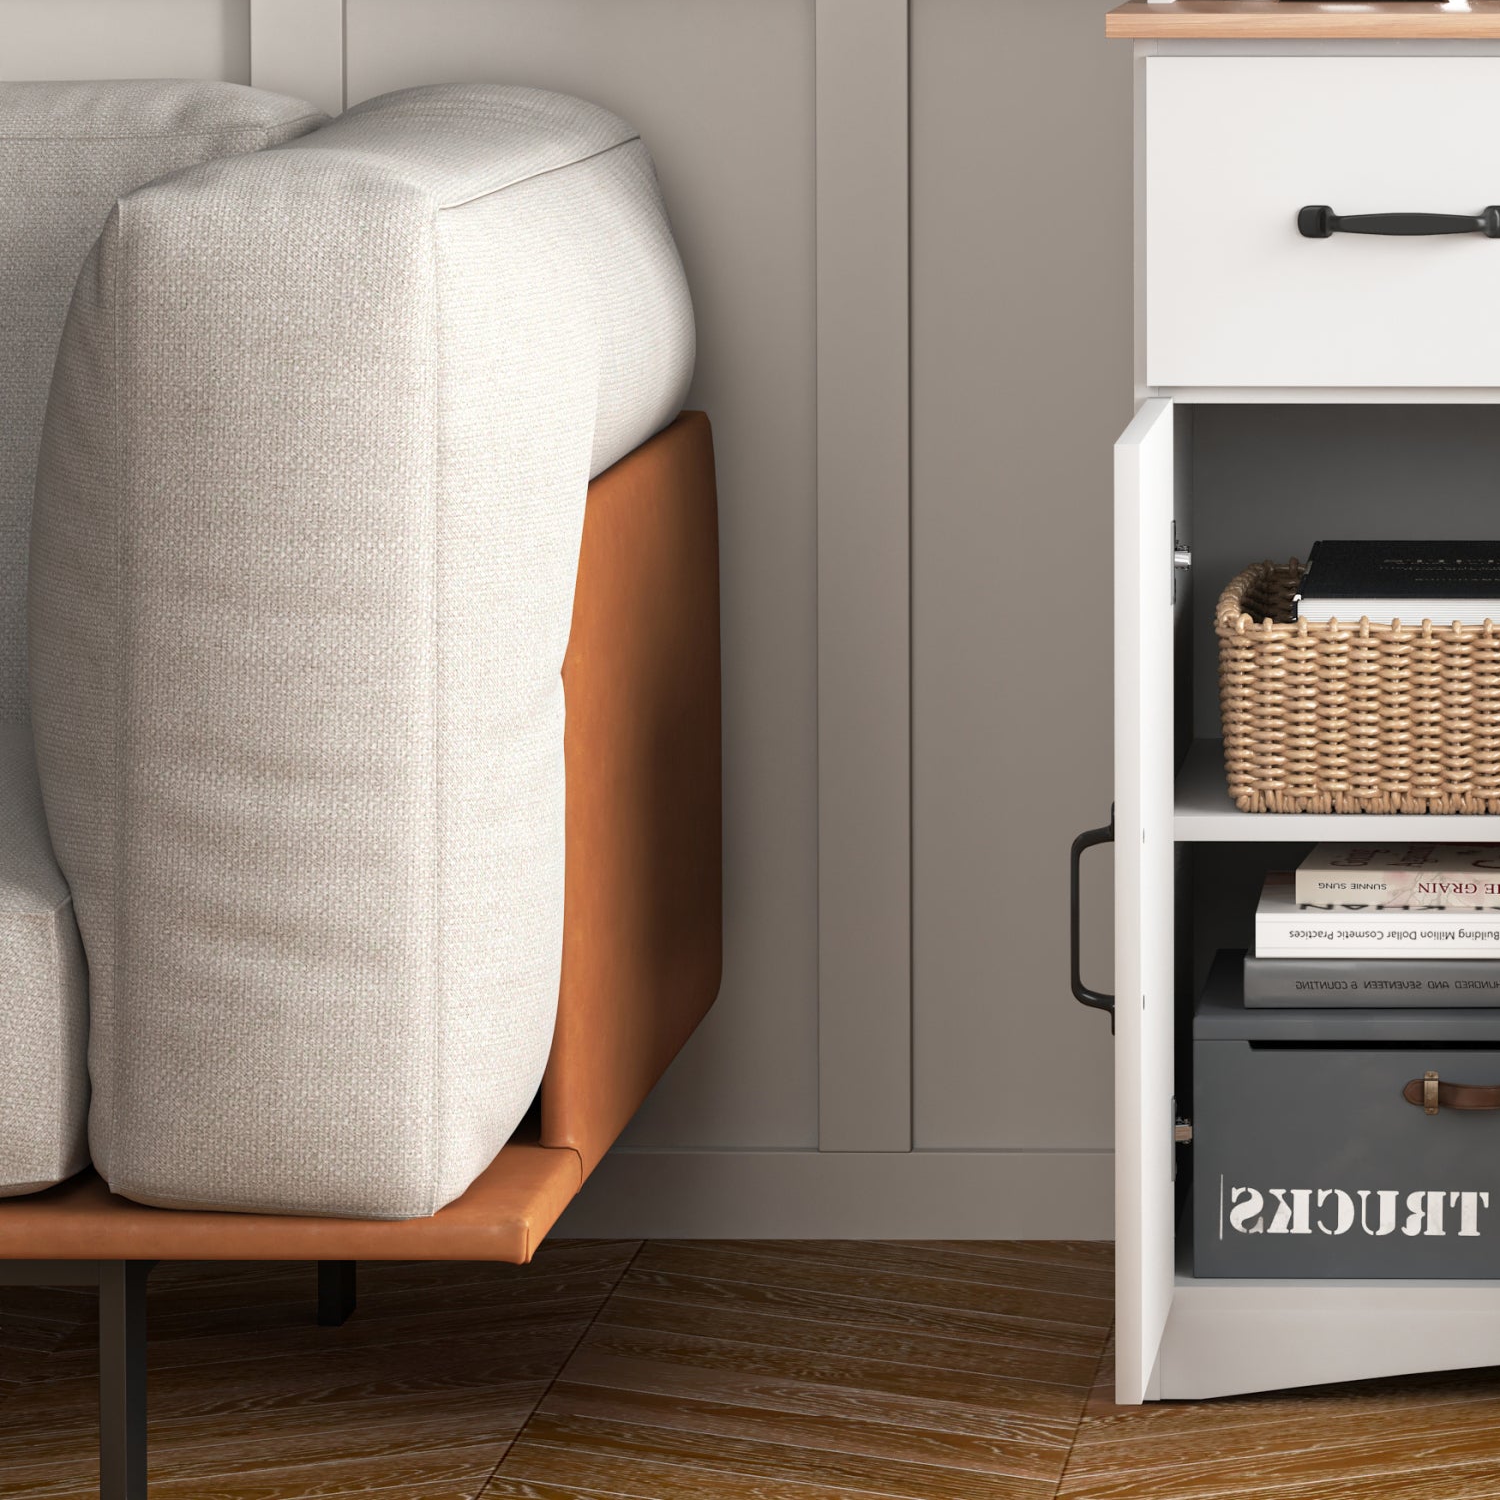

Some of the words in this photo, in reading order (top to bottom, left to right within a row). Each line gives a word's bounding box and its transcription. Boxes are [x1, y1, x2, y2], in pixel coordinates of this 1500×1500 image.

[1418, 883, 1478, 894] GRAIN
[1289, 931, 1333, 940] Practices
[1337, 931, 1384, 940] Cosmetic
[1387, 931, 1417, 940] Dollar
[1420, 931, 1455, 940] Million
[1459, 929, 1499, 940] Building
